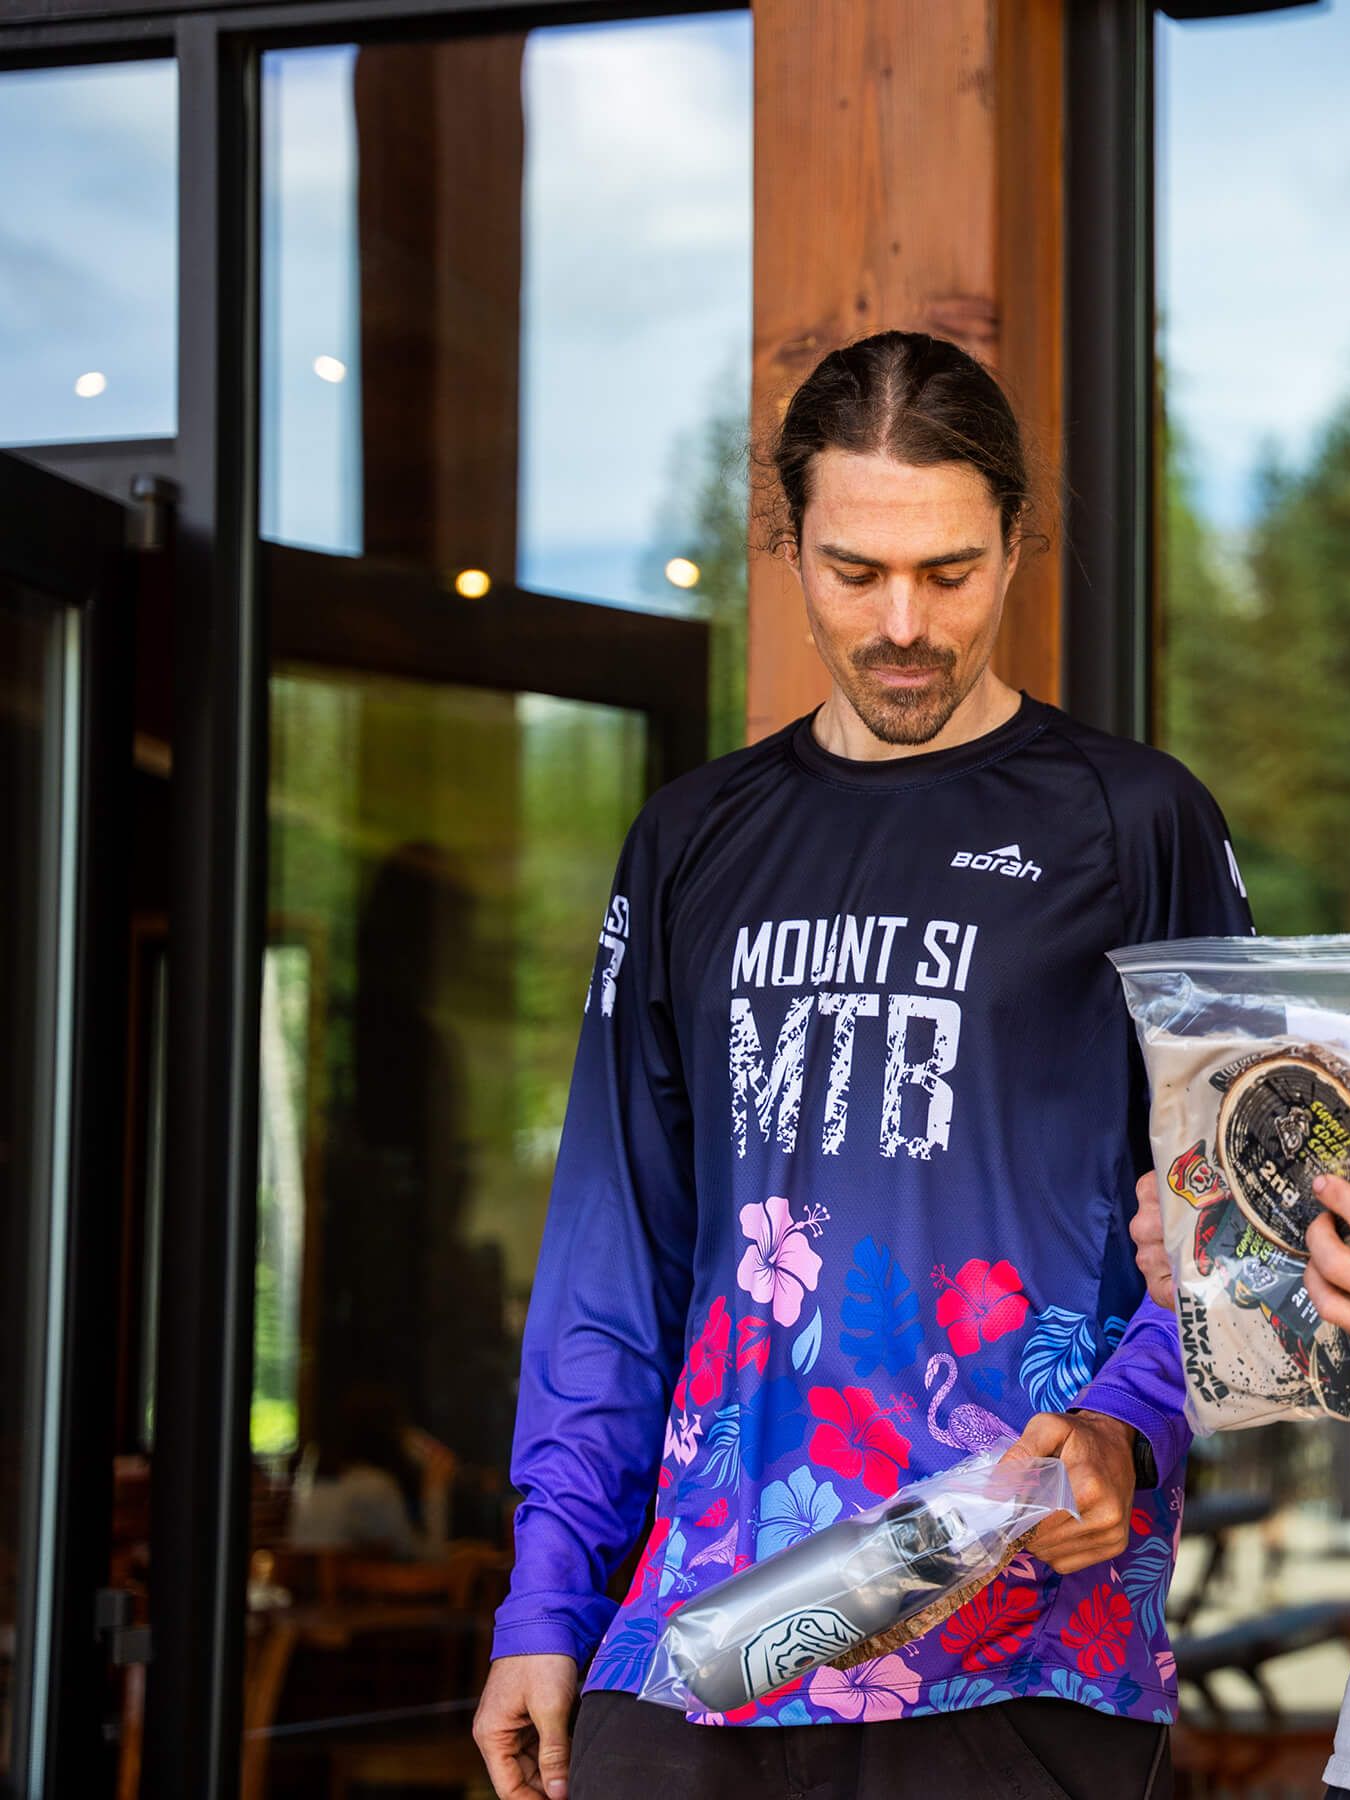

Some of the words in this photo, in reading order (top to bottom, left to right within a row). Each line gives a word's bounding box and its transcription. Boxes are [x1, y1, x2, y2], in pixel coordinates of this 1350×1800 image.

[731, 914, 908, 990] MOUNT
[915, 920, 979, 992] SI
[729, 992, 962, 1160] MTB
[1312, 1124, 1348, 1158] SPEED
[1291, 1286, 1308, 1308] 2n
